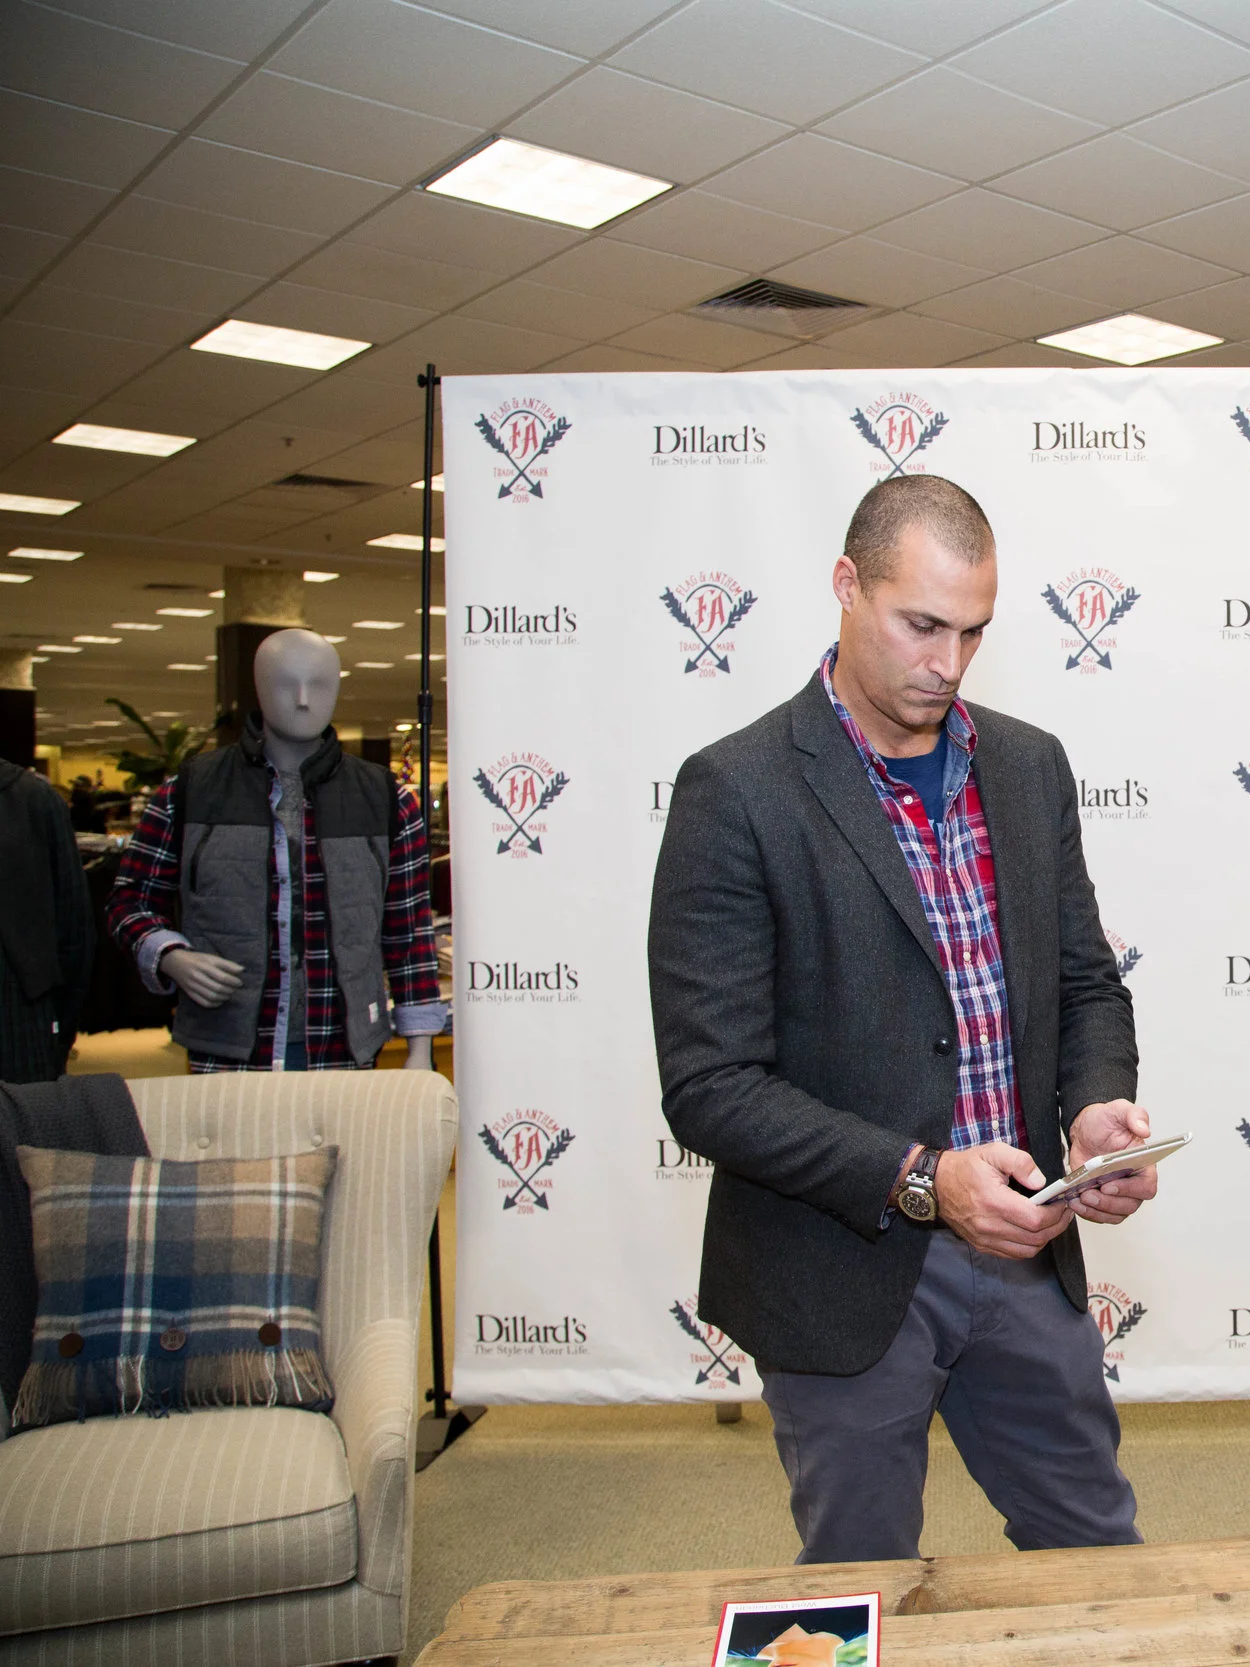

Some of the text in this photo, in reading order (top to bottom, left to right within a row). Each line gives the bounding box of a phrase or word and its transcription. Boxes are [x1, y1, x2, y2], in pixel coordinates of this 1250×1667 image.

[490, 400, 512, 422] FLAG
[522, 397, 556, 422] ANTHEM
[866, 395, 889, 417] FLAG
[899, 392, 934, 417] ANTHEM
[652, 425, 766, 454] Dillard's
[1032, 421, 1146, 450] Dillard's
[1057, 571, 1080, 593] FLAG
[1090, 568, 1125, 593] ANTHEM
[464, 605, 577, 634] Dillard's
[1061, 638, 1118, 648] TRADE MARK
[1221, 629, 1241, 639] The
[1080, 664, 1098, 674] 2016
[1080, 778, 1148, 807] lard's
[1082, 810, 1093, 820] of
[1098, 809, 1124, 820] Your
[1104, 929, 1128, 952] THEM
[467, 962, 579, 990] Dillard's
[465, 992, 485, 1002] The
[487, 992, 513, 1004] Style
[515, 992, 527, 1002] of
[530, 992, 554, 1002] Your
[494, 1112, 516, 1134] FLAG
[526, 1109, 560, 1134] ANTHEM
[498, 1179, 553, 1189] TRADE MARK
[516, 1205, 534, 1215] 2016
[1097, 1282, 1132, 1309] ANTHEM
[475, 1315, 587, 1343] Dillard's
[473, 1345, 493, 1355] The
[495, 1344, 521, 1357] Style
[523, 1345, 535, 1355] of
[538, 1345, 562, 1355] Your
[1105, 1352, 1126, 1361] MARK
